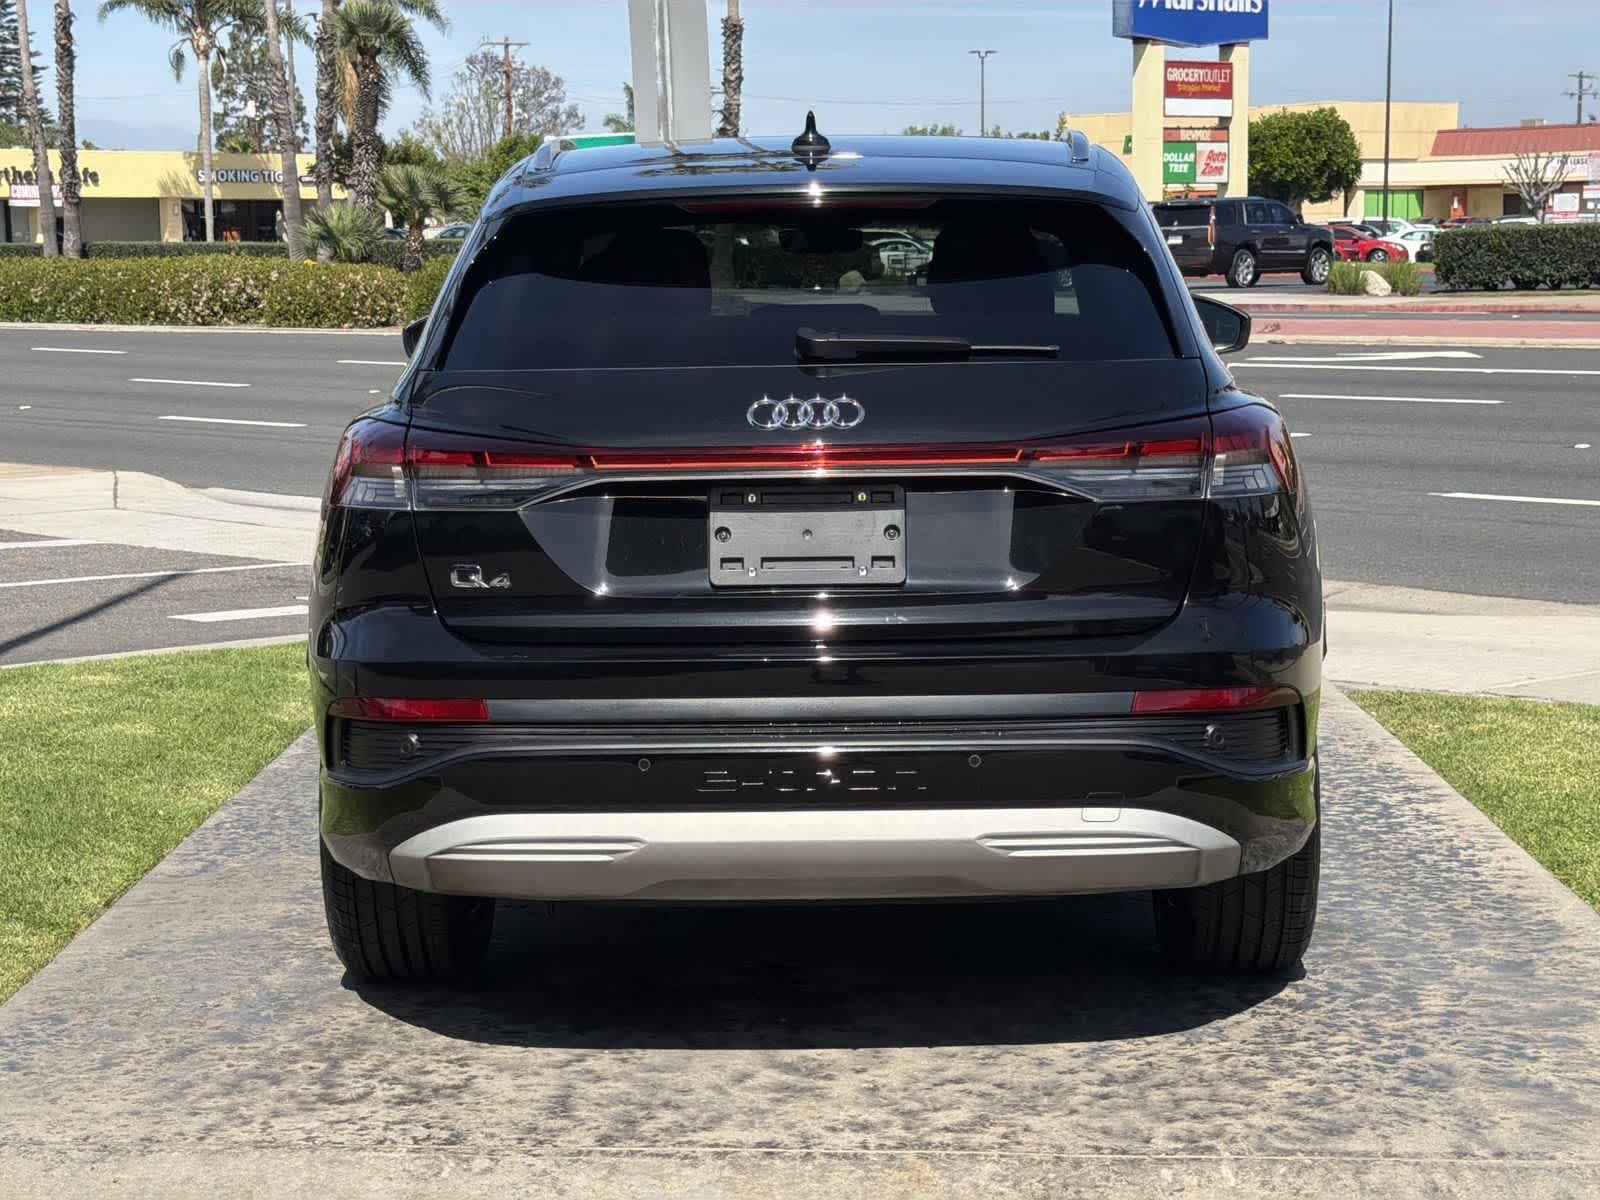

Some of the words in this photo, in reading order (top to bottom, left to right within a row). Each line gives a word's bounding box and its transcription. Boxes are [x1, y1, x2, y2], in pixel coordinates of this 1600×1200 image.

[1163, 152, 1195, 162] DOLLAR
[1168, 163, 1189, 173] TREE
[450, 564, 512, 589] Q4
